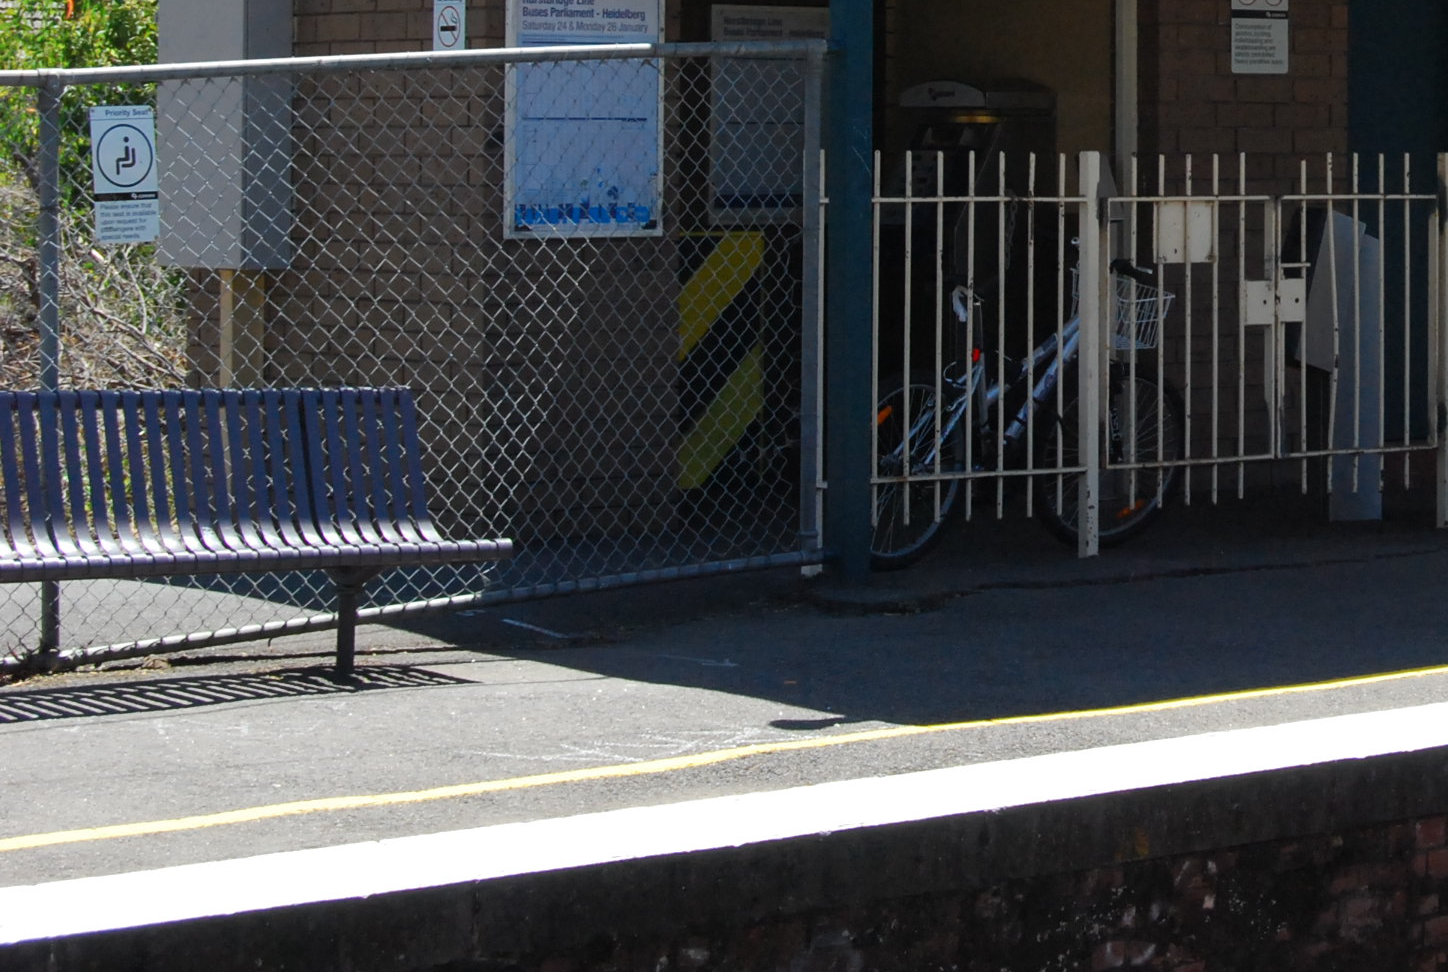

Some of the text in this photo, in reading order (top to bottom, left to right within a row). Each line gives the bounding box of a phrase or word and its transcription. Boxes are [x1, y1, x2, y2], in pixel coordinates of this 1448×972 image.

[522, 7, 548, 18] Buses
[550, 8, 594, 19] Parliament
[602, 9, 645, 22] Heidelberg
[522, 20, 556, 32] Saturday
[558, 21, 567, 30] 24
[576, 22, 605, 33] Monday
[618, 23, 648, 34] January
[105, 108, 148, 117] Priority Seat
